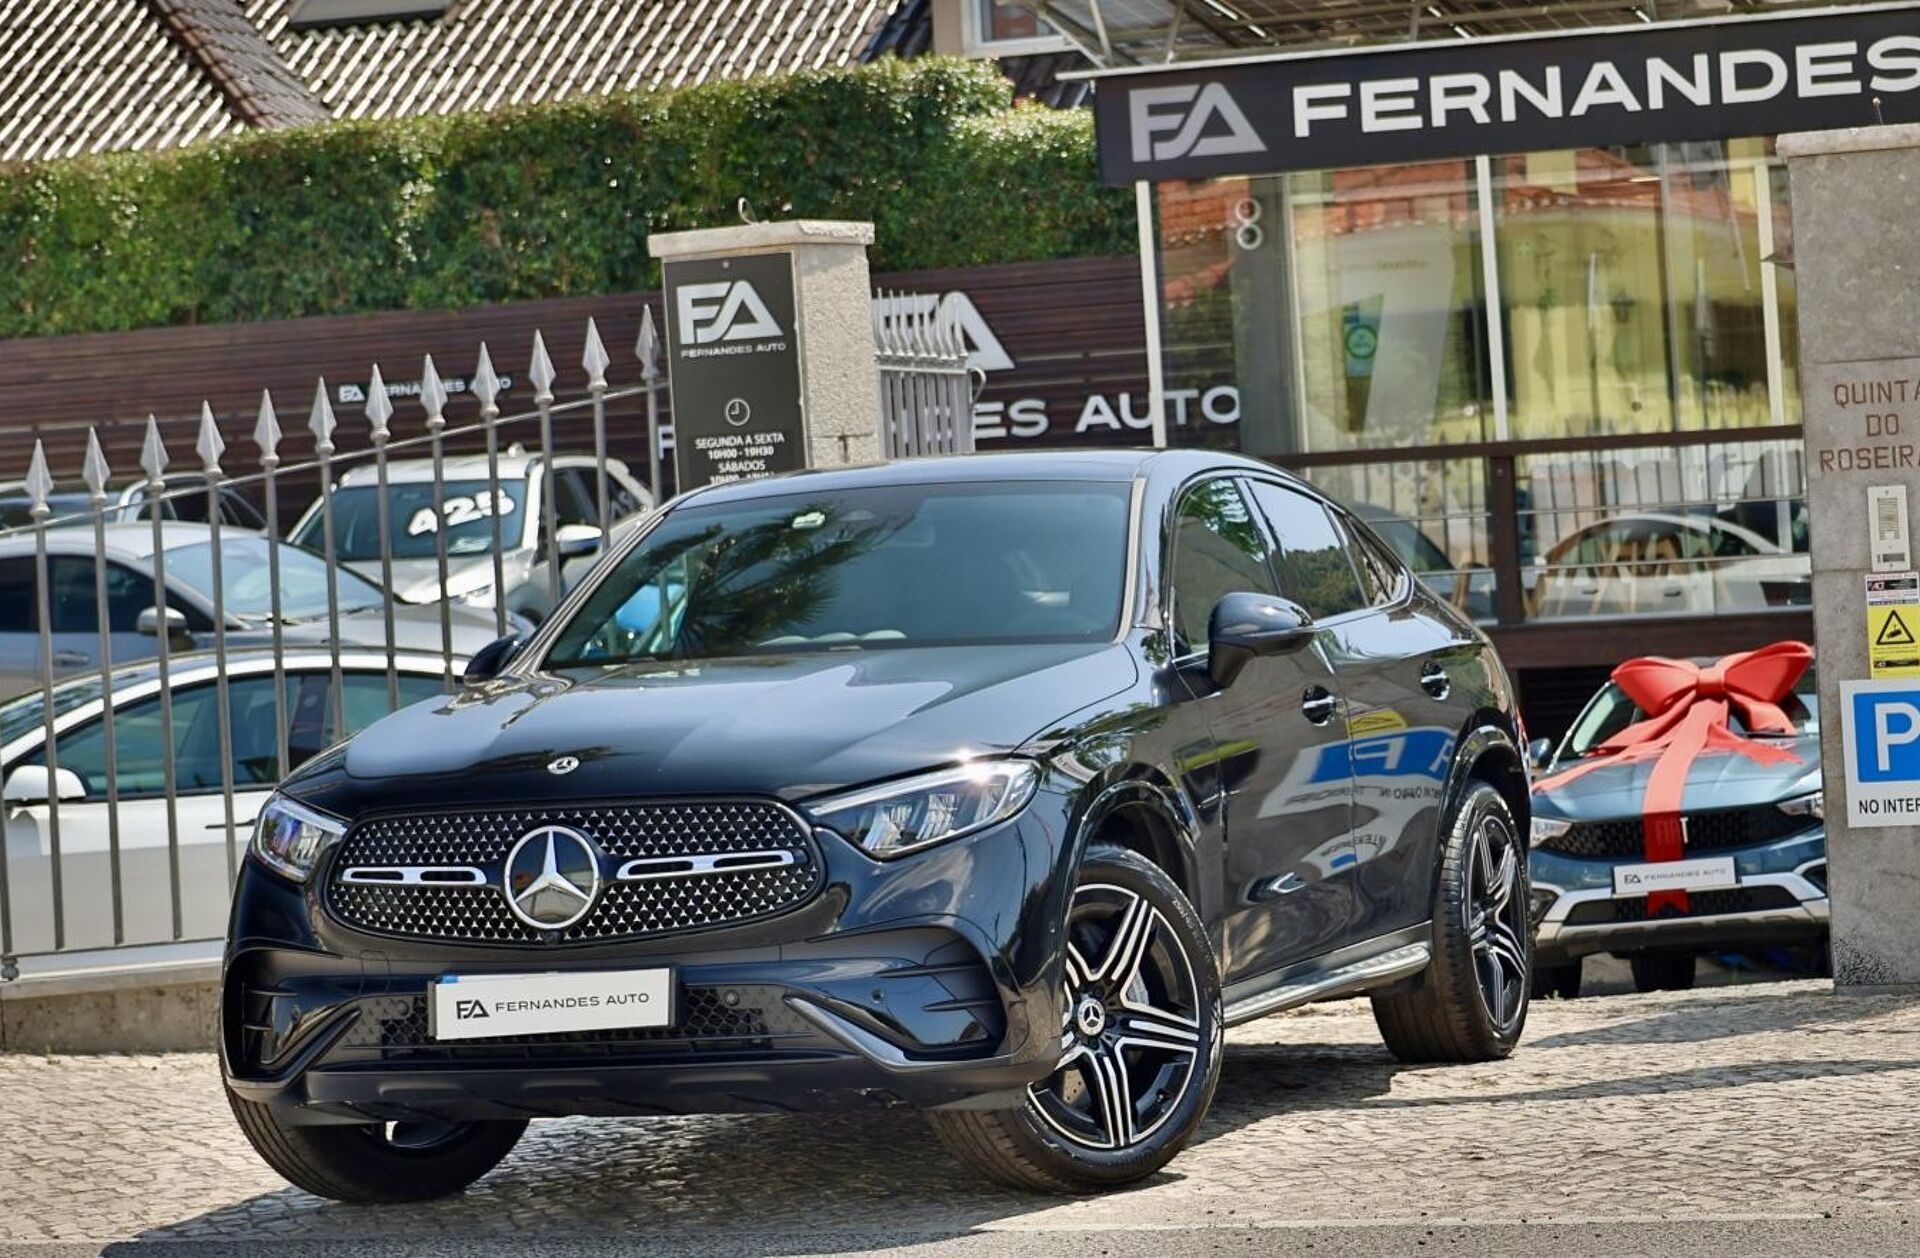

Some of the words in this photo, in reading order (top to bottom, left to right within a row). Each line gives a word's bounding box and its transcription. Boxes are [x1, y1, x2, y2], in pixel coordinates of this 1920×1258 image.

[1129, 81, 1268, 162] FA
[1293, 34, 1920, 137] FERNANDES
[677, 280, 784, 345] FA
[681, 346, 753, 359] FERNANDES
[755, 342, 787, 353] AUTO
[1075, 386, 1240, 434] AUTO
[1866, 413, 1899, 437] DO
[694, 435, 744, 450] SEGUNDA
[745, 434, 753, 446] A
[754, 431, 785, 445] SEXTA
[1820, 445, 1920, 472] ROSEIR
[1875, 702, 1920, 771] P
[1859, 800, 1880, 814] NO
[1644, 871, 1700, 880] FERNANDES
[1702, 868, 1726, 876] AUTO
[456, 1000, 489, 1020] FA
[495, 996, 600, 1012] FERNANDES
[606, 993, 650, 1005] AUTO
